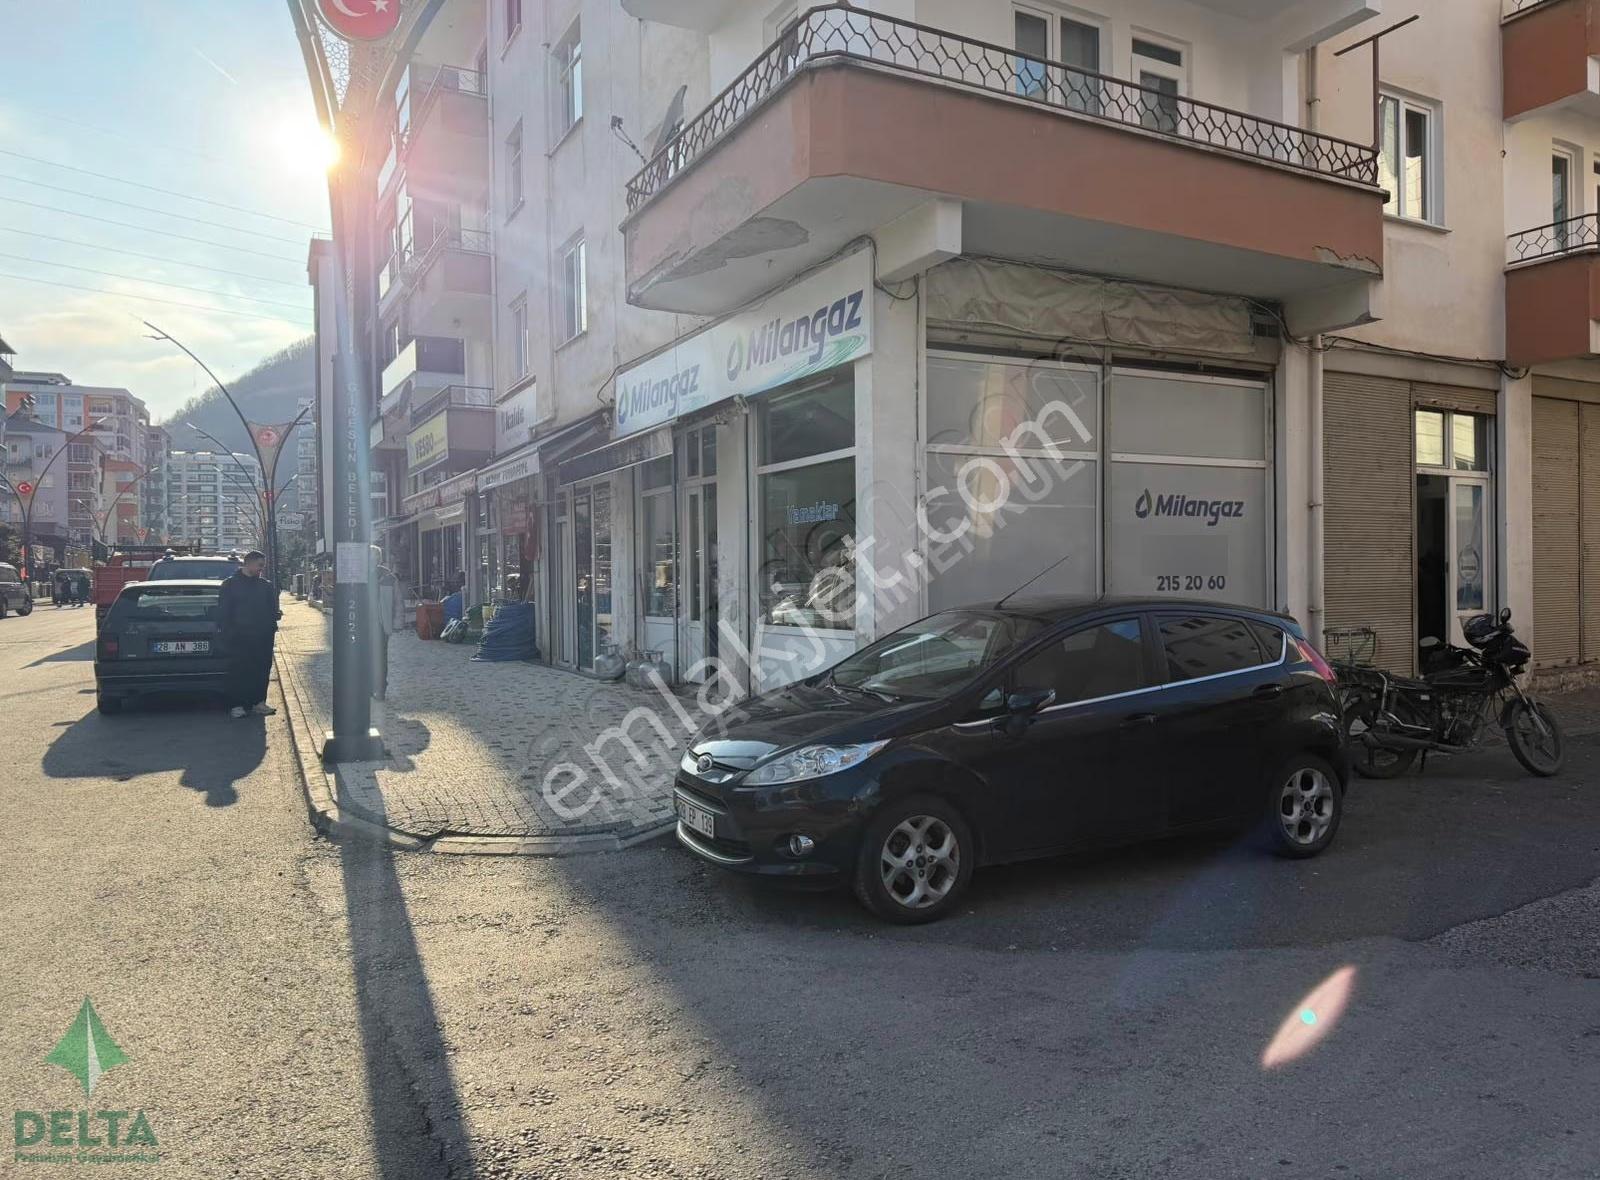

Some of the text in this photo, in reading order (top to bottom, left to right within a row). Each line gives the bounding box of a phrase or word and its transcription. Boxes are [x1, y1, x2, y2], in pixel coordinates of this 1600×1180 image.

[745, 290, 864, 370] Milangaz
[630, 364, 700, 418] Milangaz
[1154, 494, 1244, 526] Milangaz
[1156, 575, 1226, 591] 215 20 60
[176, 642, 186, 651] AN
